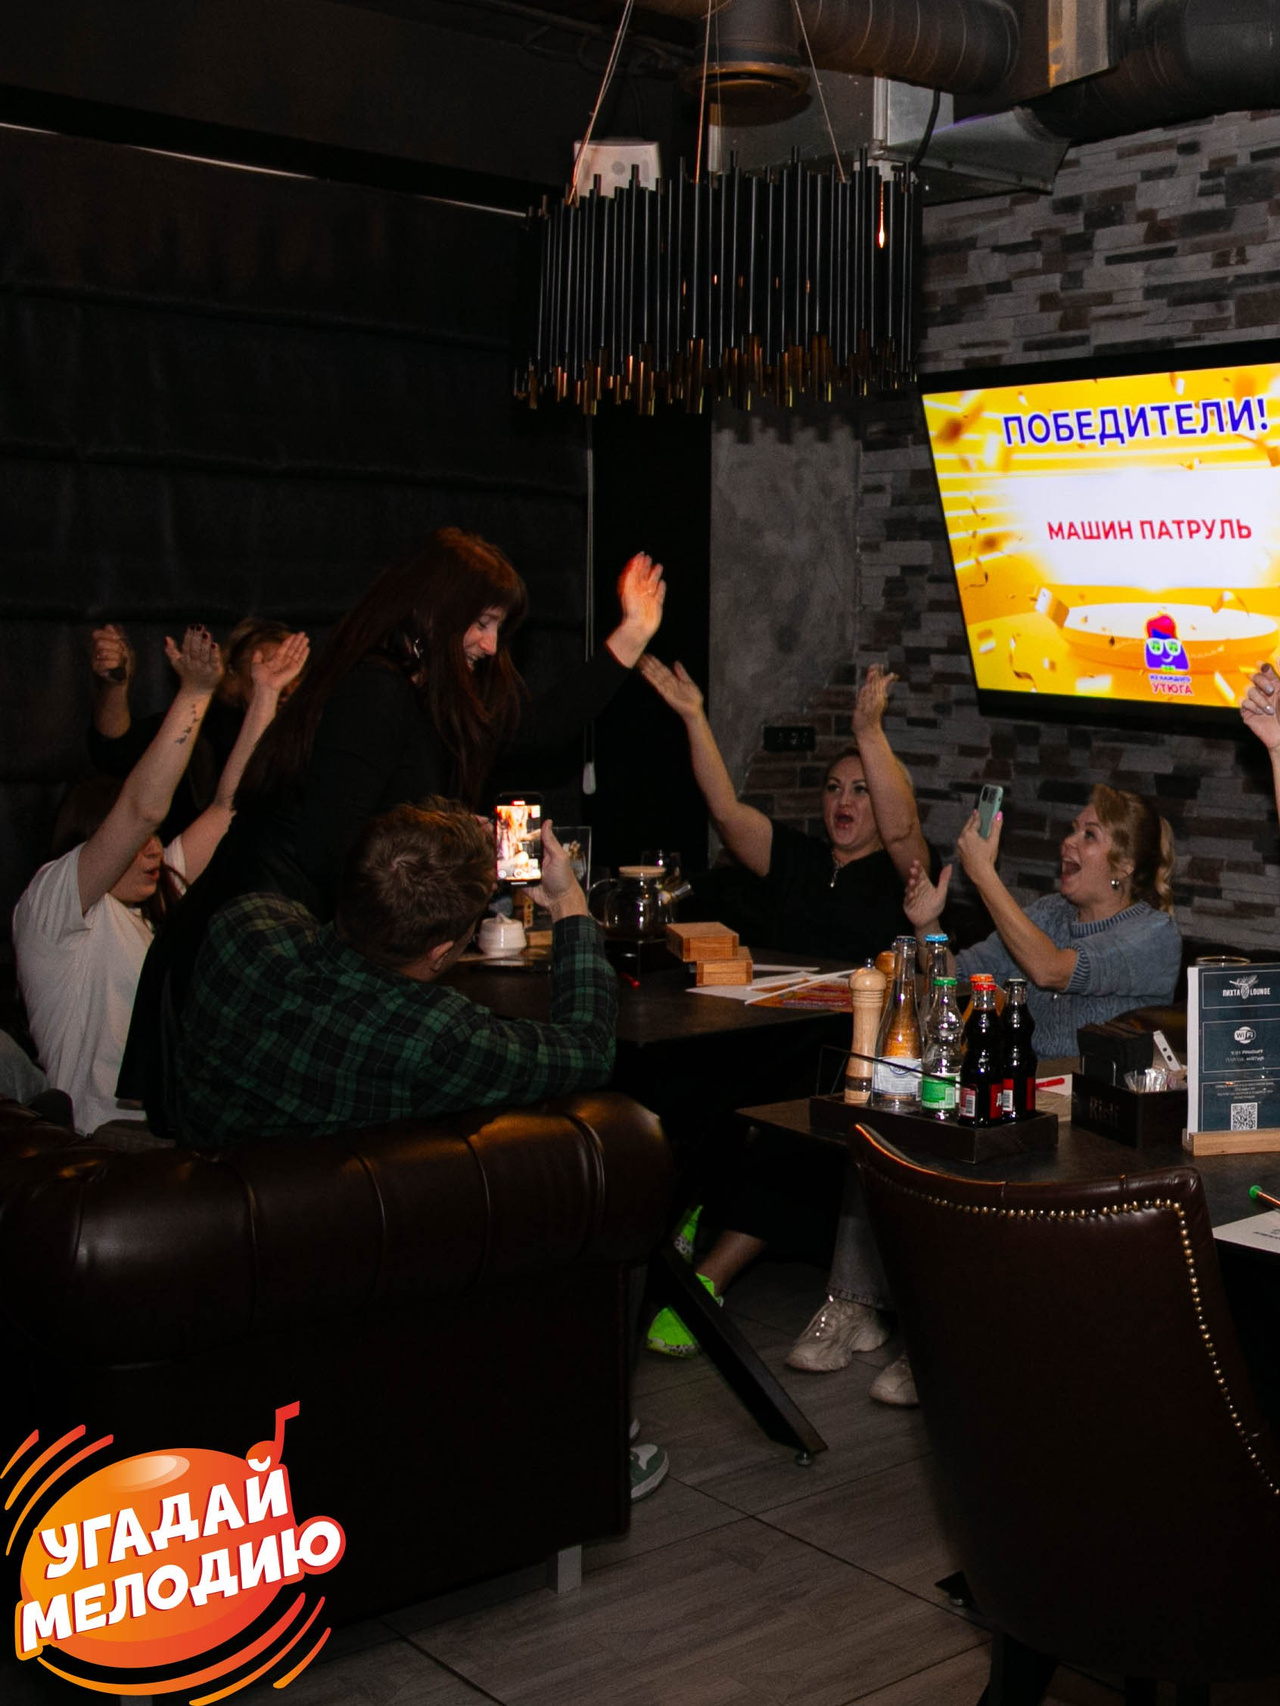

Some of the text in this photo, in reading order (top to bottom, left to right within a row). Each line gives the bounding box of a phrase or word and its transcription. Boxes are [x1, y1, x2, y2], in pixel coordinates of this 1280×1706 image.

[1002, 397, 1269, 446] ПОБЕДИТЕЛИ!
[1047, 517, 1252, 541] МАШИН ПАТРУЛЬ
[1151, 682, 1193, 695] УТЮГА
[1250, 987, 1271, 996] LOUNGE
